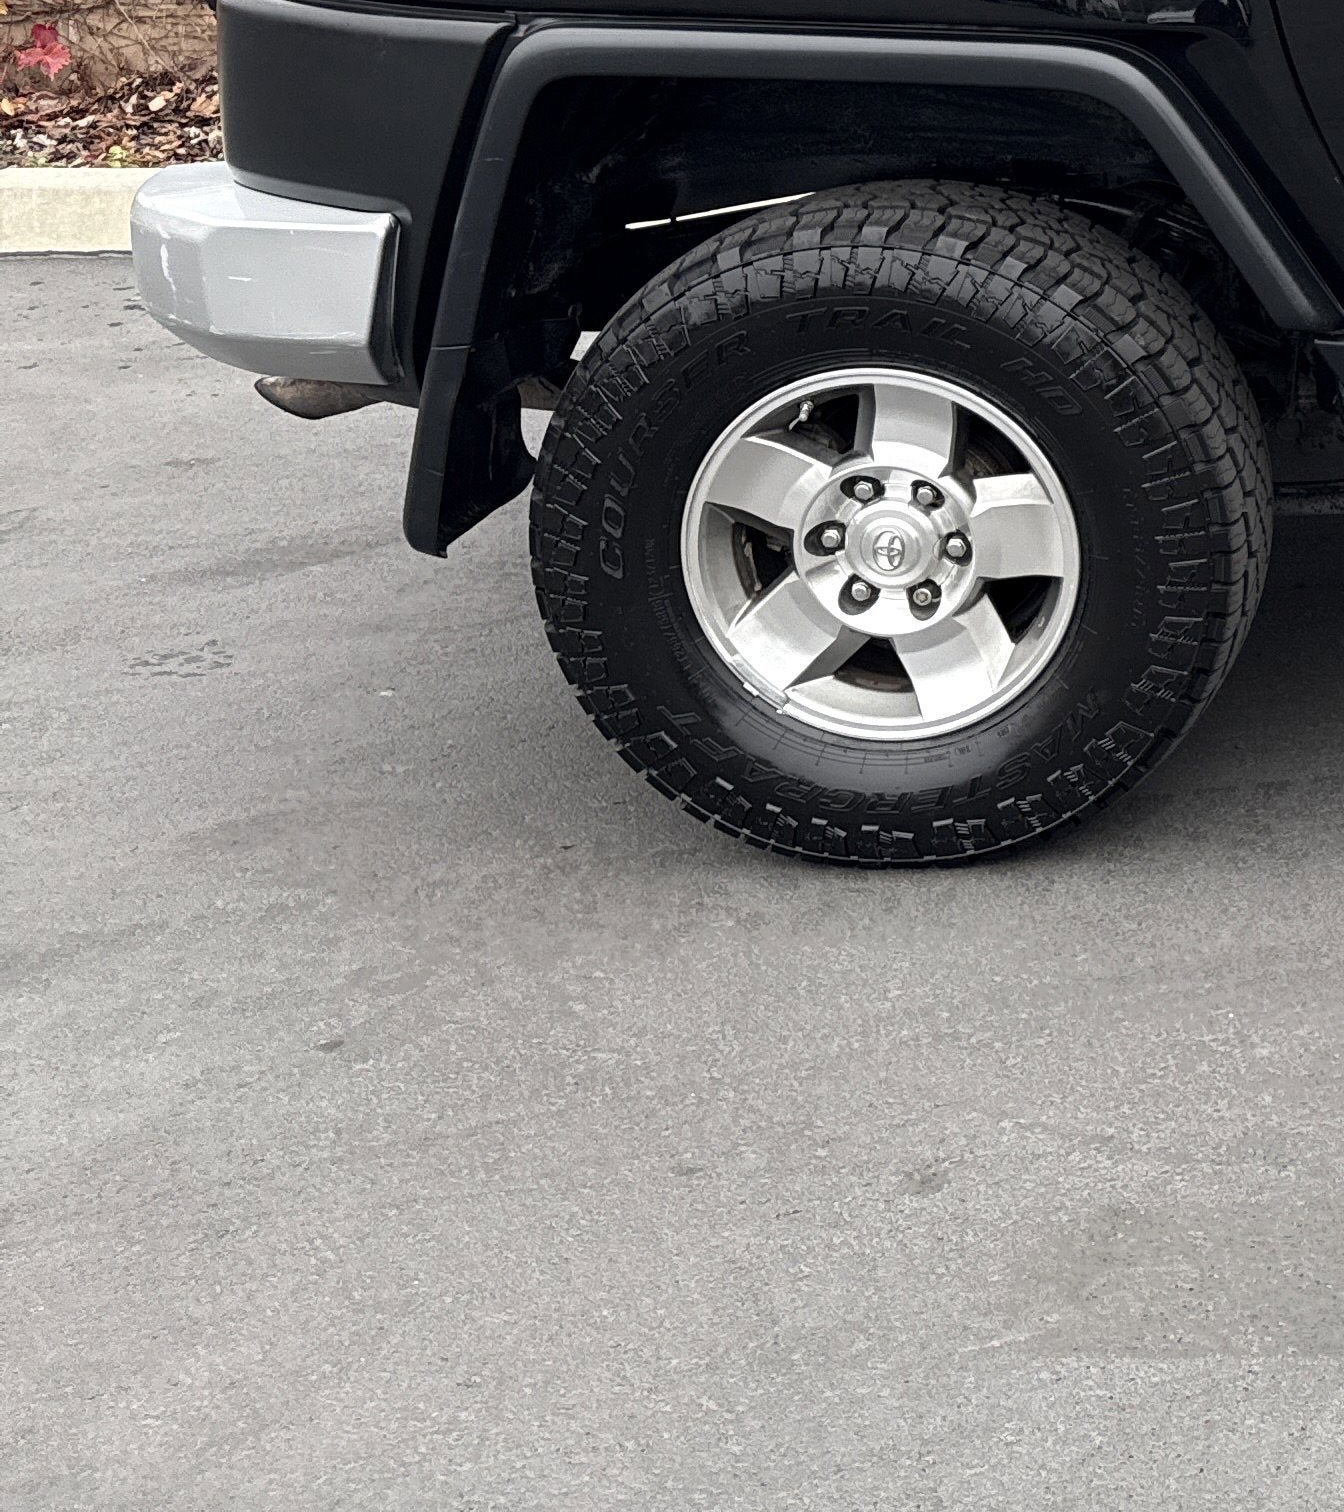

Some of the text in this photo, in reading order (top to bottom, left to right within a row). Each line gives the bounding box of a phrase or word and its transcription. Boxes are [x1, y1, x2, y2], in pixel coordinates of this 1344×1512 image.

[600, 305, 1082, 580] COURSER TRAIL HD
[658, 690, 1102, 816] MASTERCRAFT
